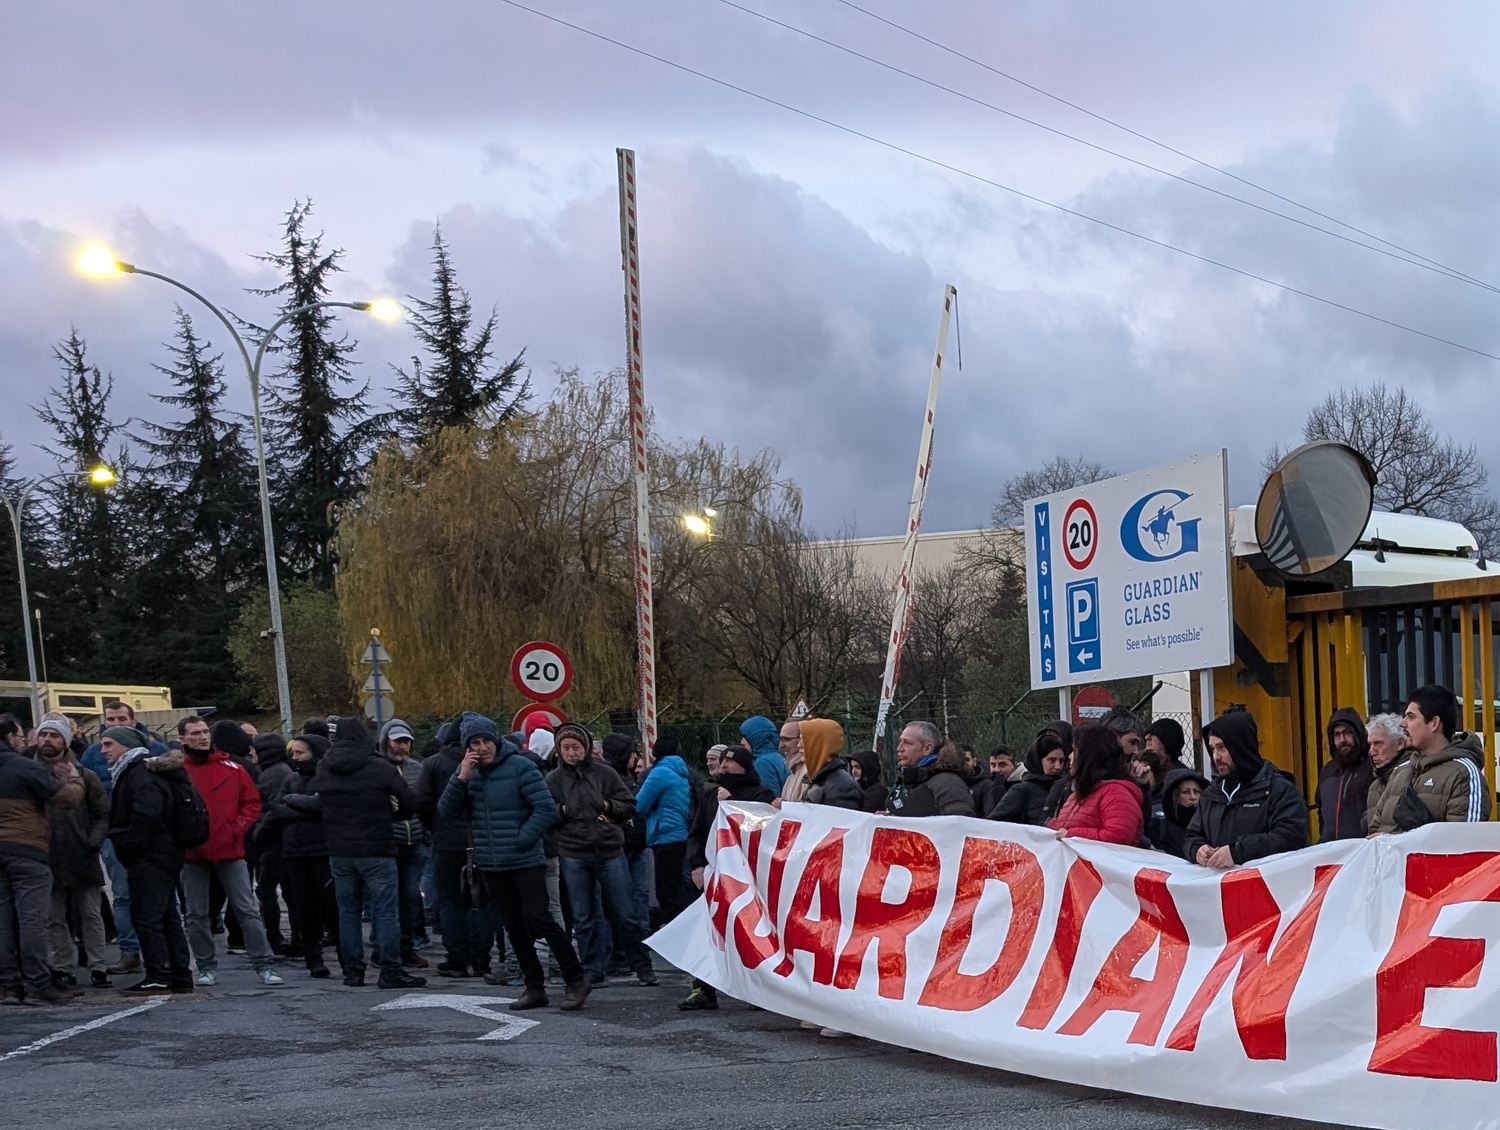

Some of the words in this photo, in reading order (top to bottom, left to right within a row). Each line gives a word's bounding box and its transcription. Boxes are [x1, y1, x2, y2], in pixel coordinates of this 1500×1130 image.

[1069, 520, 1091, 550] 20
[1038, 511, 1052, 673] VISITAS
[1123, 571, 1199, 602] GUARDIAN
[1125, 602, 1170, 626] GLASS
[1126, 638, 1140, 651] See
[1141, 634, 1166, 649] what's
[1168, 628, 1200, 648] possible
[525, 661, 560, 682] 20
